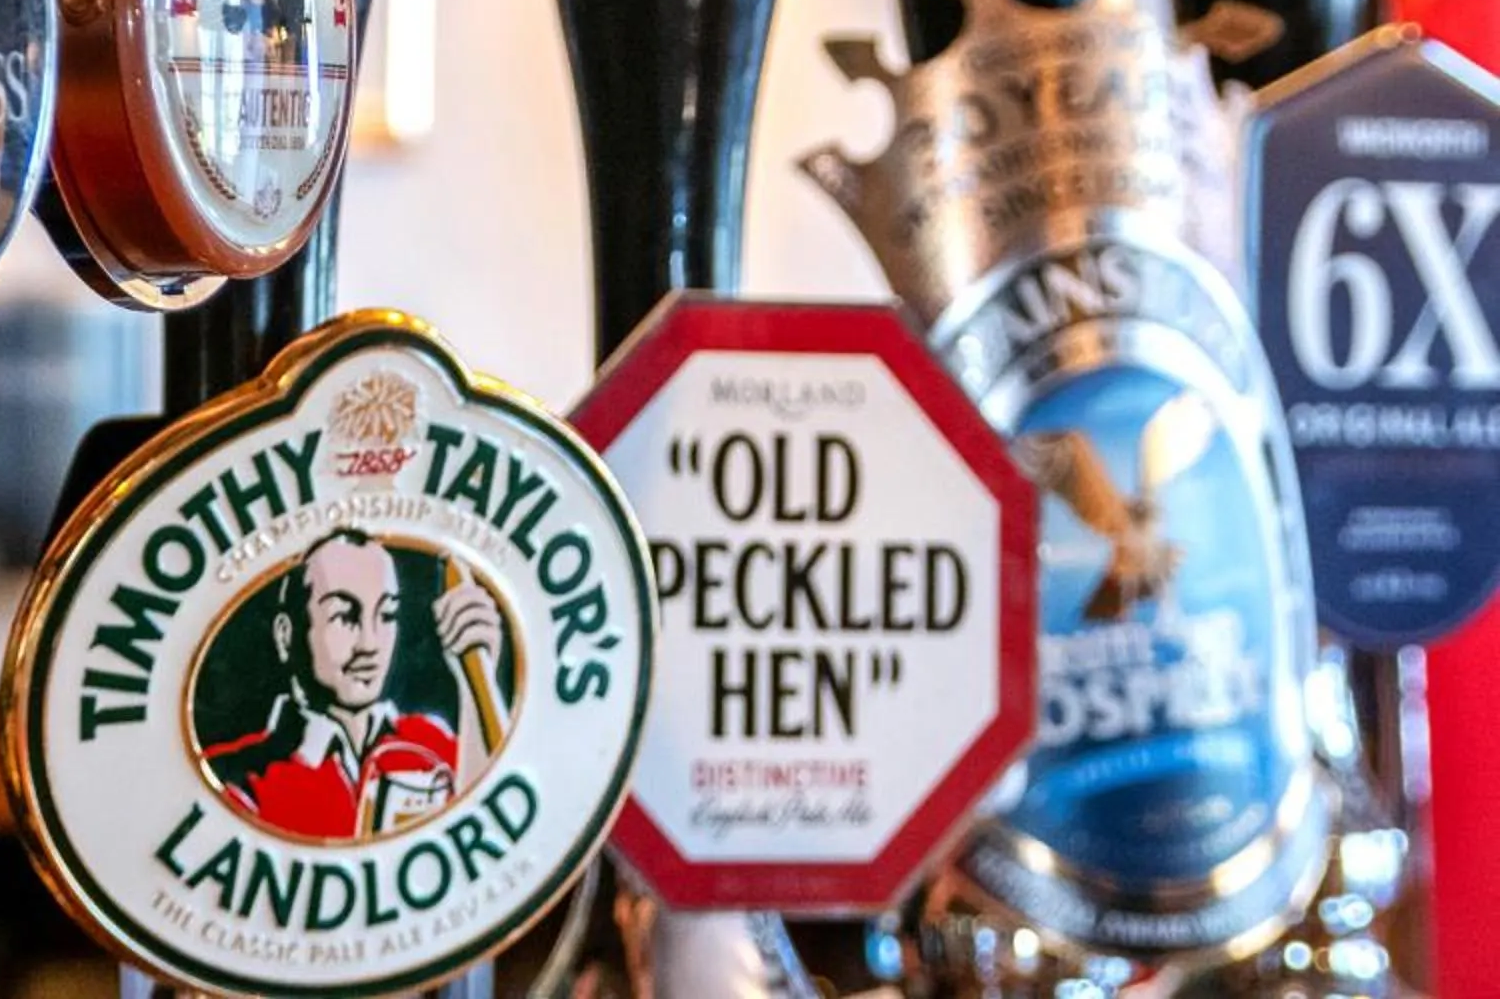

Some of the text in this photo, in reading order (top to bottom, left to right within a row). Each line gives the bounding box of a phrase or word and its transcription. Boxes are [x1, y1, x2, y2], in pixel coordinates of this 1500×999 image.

[1286, 176, 1500, 393] 6X
[708, 375, 868, 422] MORLAND
[336, 446, 417, 477] 1858
[80, 422, 623, 741] TIMOTHY TAYLOR'S
[215, 497, 432, 584] CHAMPIONSHIP
[649, 542, 970, 635] PECKLED
[155, 771, 541, 932] LANDLORD
[150, 890, 196, 936] THE
[200, 920, 300, 963] CLASSIC
[309, 940, 368, 967] PALE
[378, 929, 423, 957] ALE
